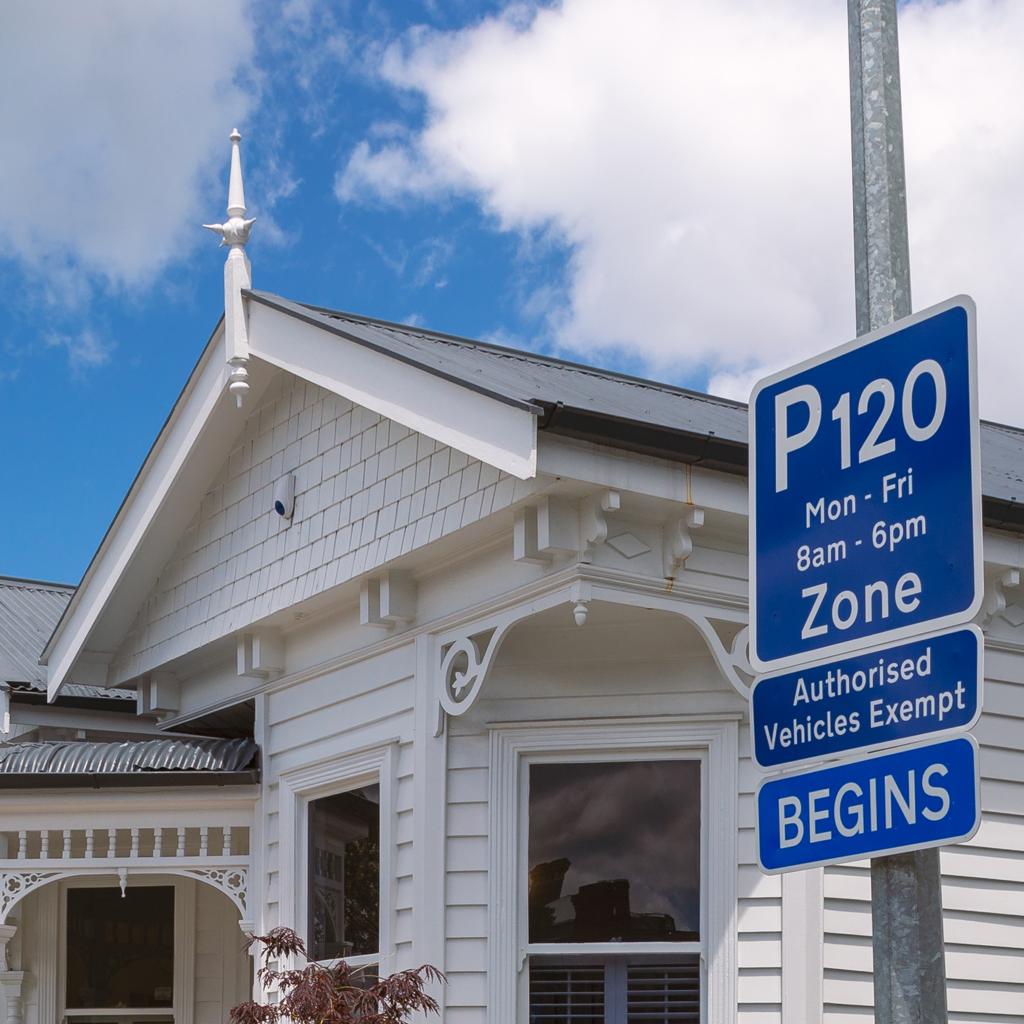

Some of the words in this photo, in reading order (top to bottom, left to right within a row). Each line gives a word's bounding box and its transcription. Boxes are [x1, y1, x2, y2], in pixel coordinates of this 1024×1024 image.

[805, 492, 856, 529] Mon
[882, 468, 913, 503] Fri
[796, 539, 847, 572] 8am
[871, 514, 926, 552] 6pm
[801, 572, 922, 640] Zone
[792, 647, 932, 706] Authorised
[764, 711, 861, 751] Vehicles
[869, 681, 966, 721] Exempt
[778, 763, 951, 849] BEGINS
